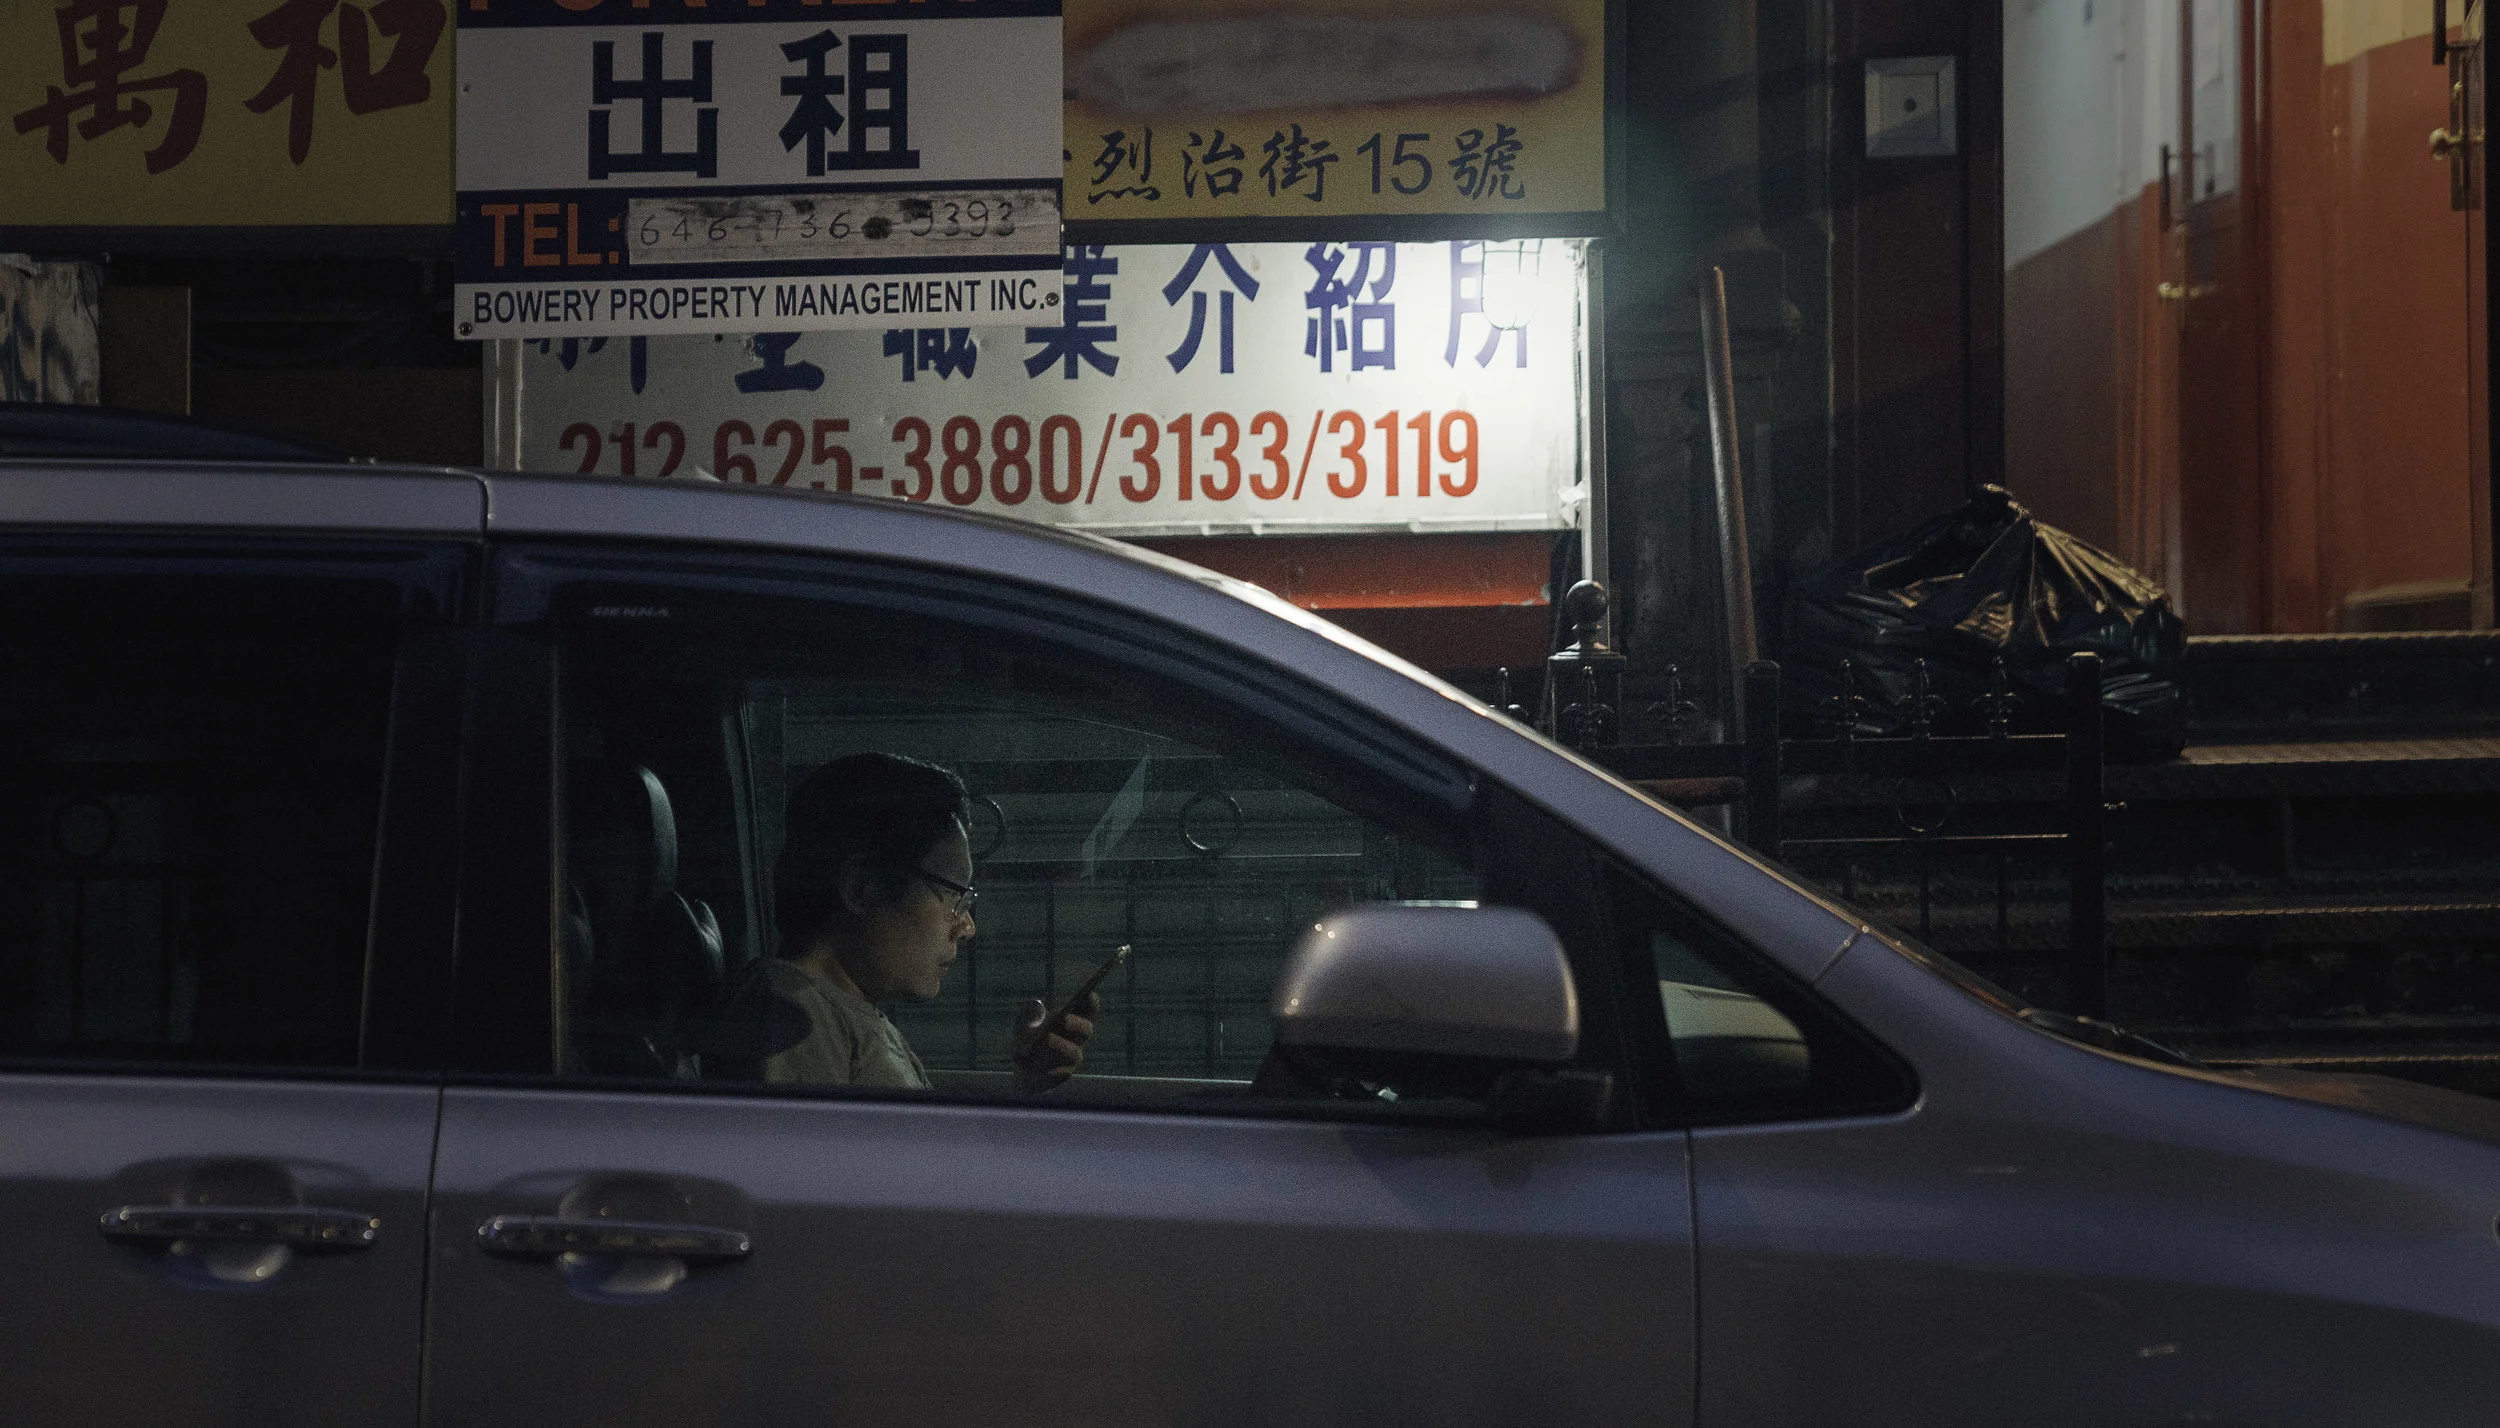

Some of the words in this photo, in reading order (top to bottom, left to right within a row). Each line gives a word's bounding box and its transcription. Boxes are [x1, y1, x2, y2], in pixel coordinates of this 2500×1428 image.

[587, 28, 921, 181] 出租
[1063, 123, 1526, 203] 烈治街15號
[481, 203, 620, 267] TEL:
[474, 289, 600, 324] BOWERY
[611, 286, 766, 321] PROPERTY
[777, 281, 980, 316] MANAGEMENT
[991, 279, 1045, 311] INC.
[559, 421, 686, 478] 212
